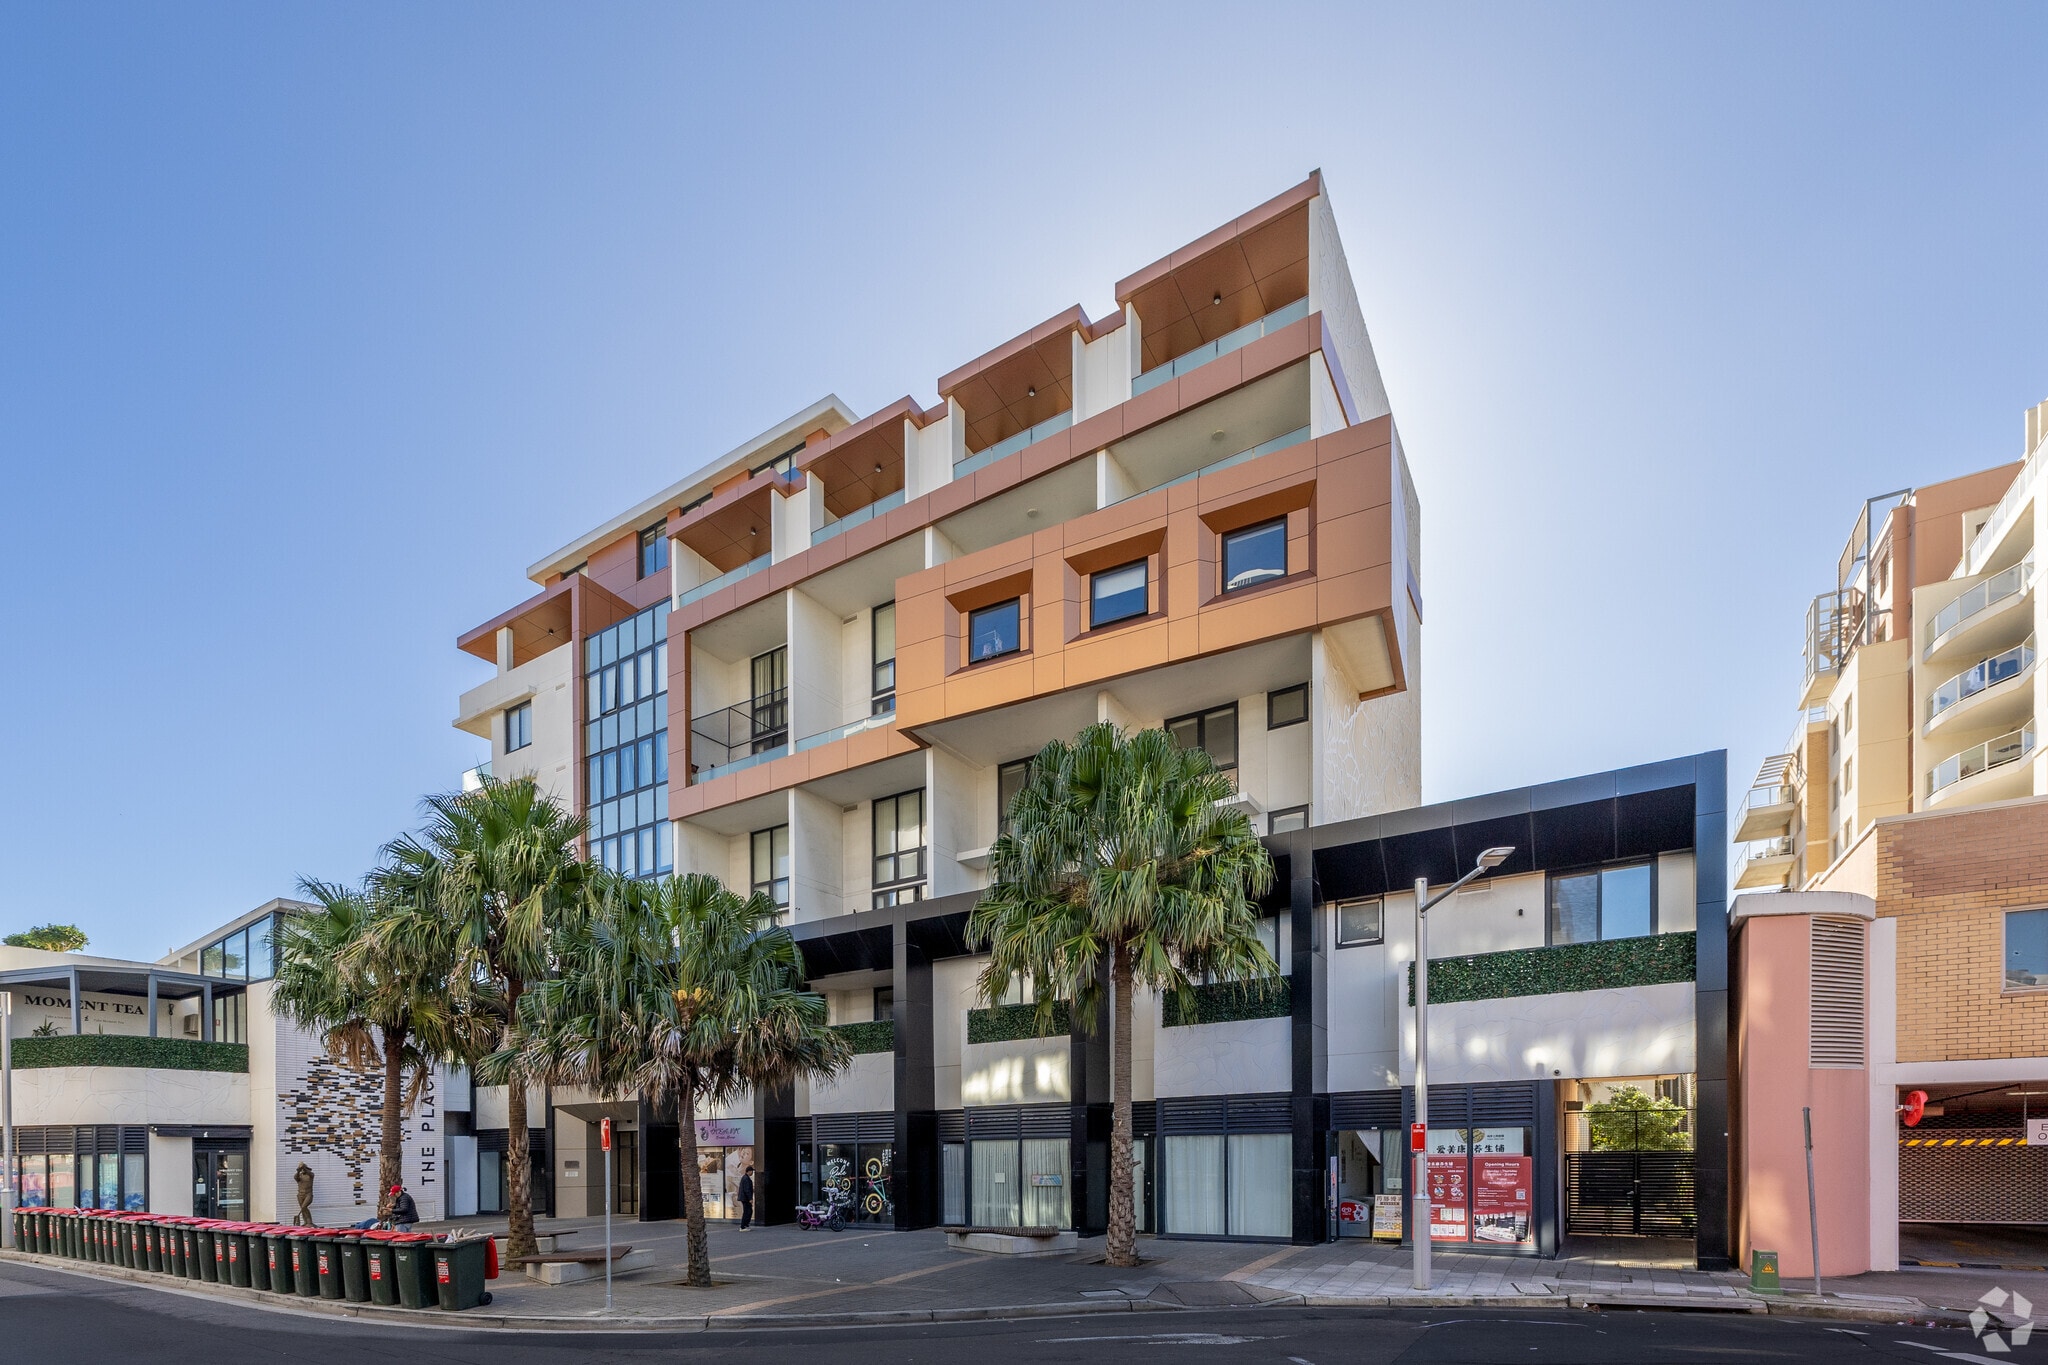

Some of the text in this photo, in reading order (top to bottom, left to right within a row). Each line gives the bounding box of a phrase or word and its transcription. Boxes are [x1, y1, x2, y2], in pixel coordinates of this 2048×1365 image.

[113, 1003, 144, 1015] TEA
[422, 1147, 435, 1186] THE
[826, 1157, 850, 1166] WELCOME
